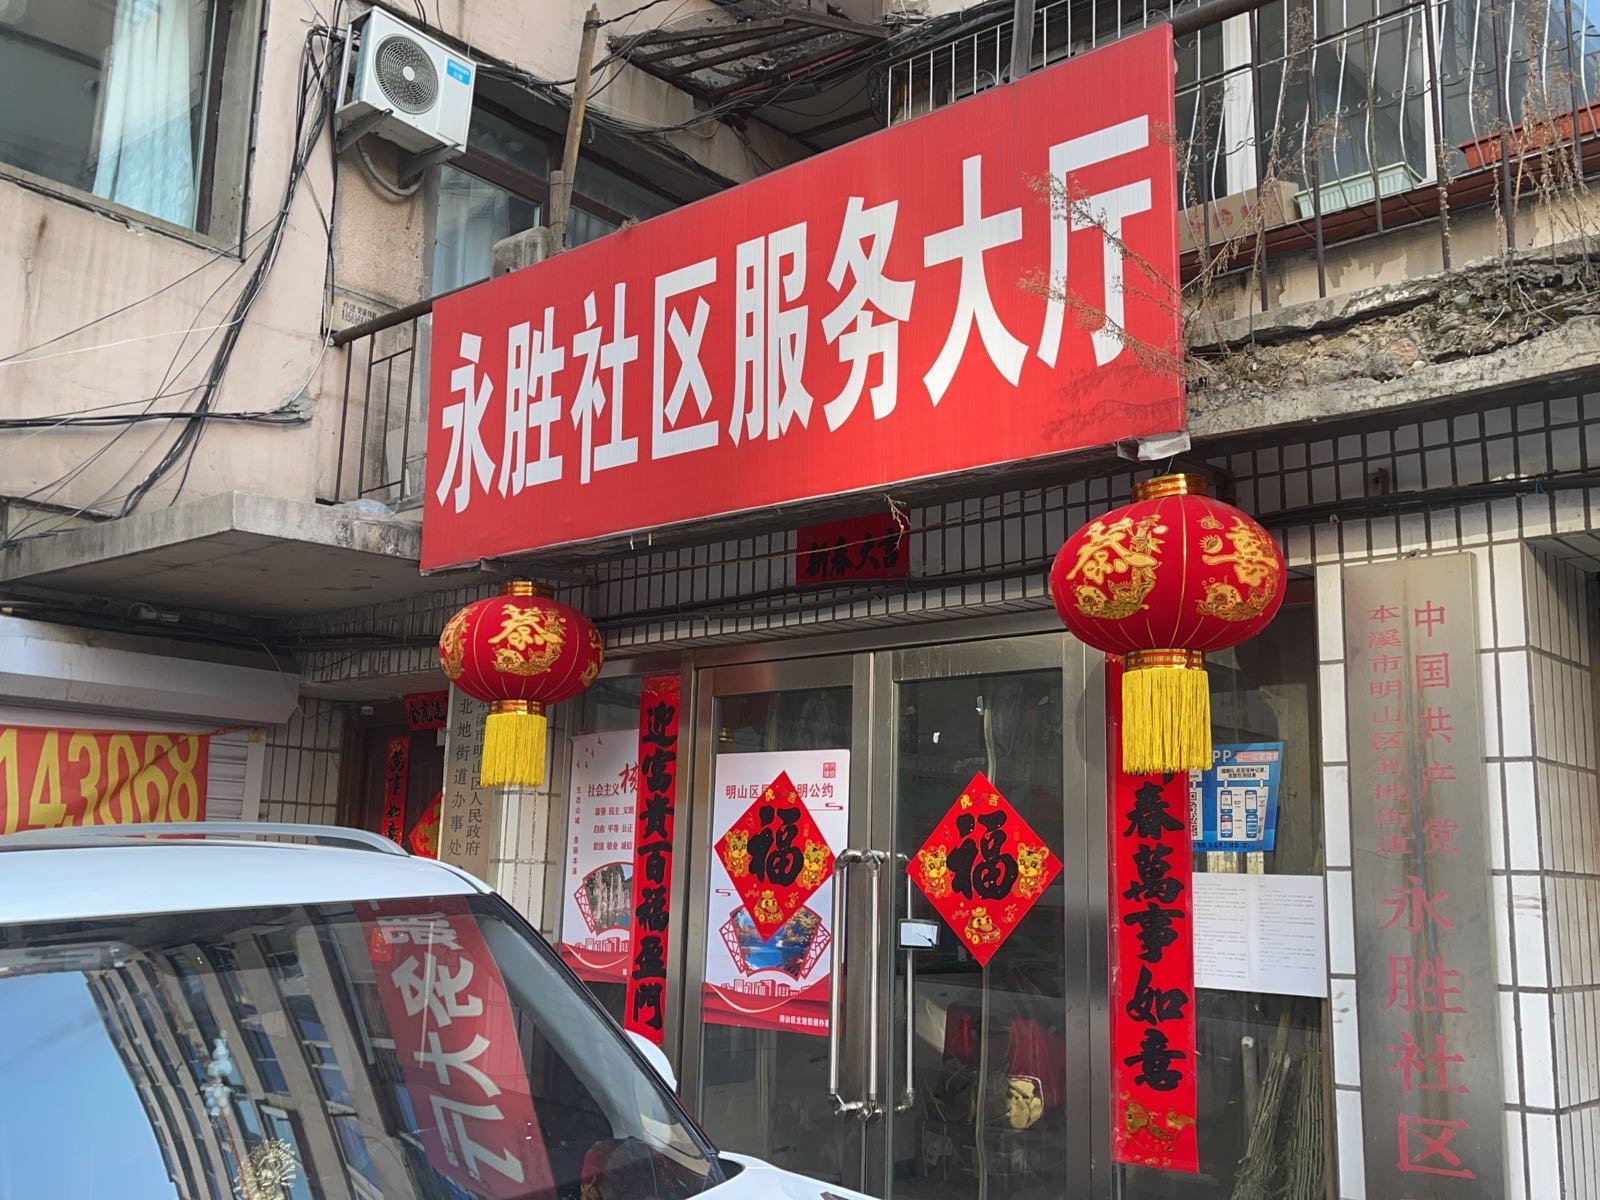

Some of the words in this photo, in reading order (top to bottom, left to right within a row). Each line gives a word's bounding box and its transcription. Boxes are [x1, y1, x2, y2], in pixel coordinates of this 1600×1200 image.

[435, 114, 1153, 514] 永胜社区服务大厅
[806, 527, 900, 577] 新春大吉
[447, 698, 473, 857] 北地街道办事处
[1367, 604, 1413, 856] 本溪市明山区北地街道
[1413, 600, 1461, 856] 中国共产党
[747, 805, 805, 887] 福
[946, 809, 1019, 900] 福
[1380, 875, 1477, 1181] 永胜社区
